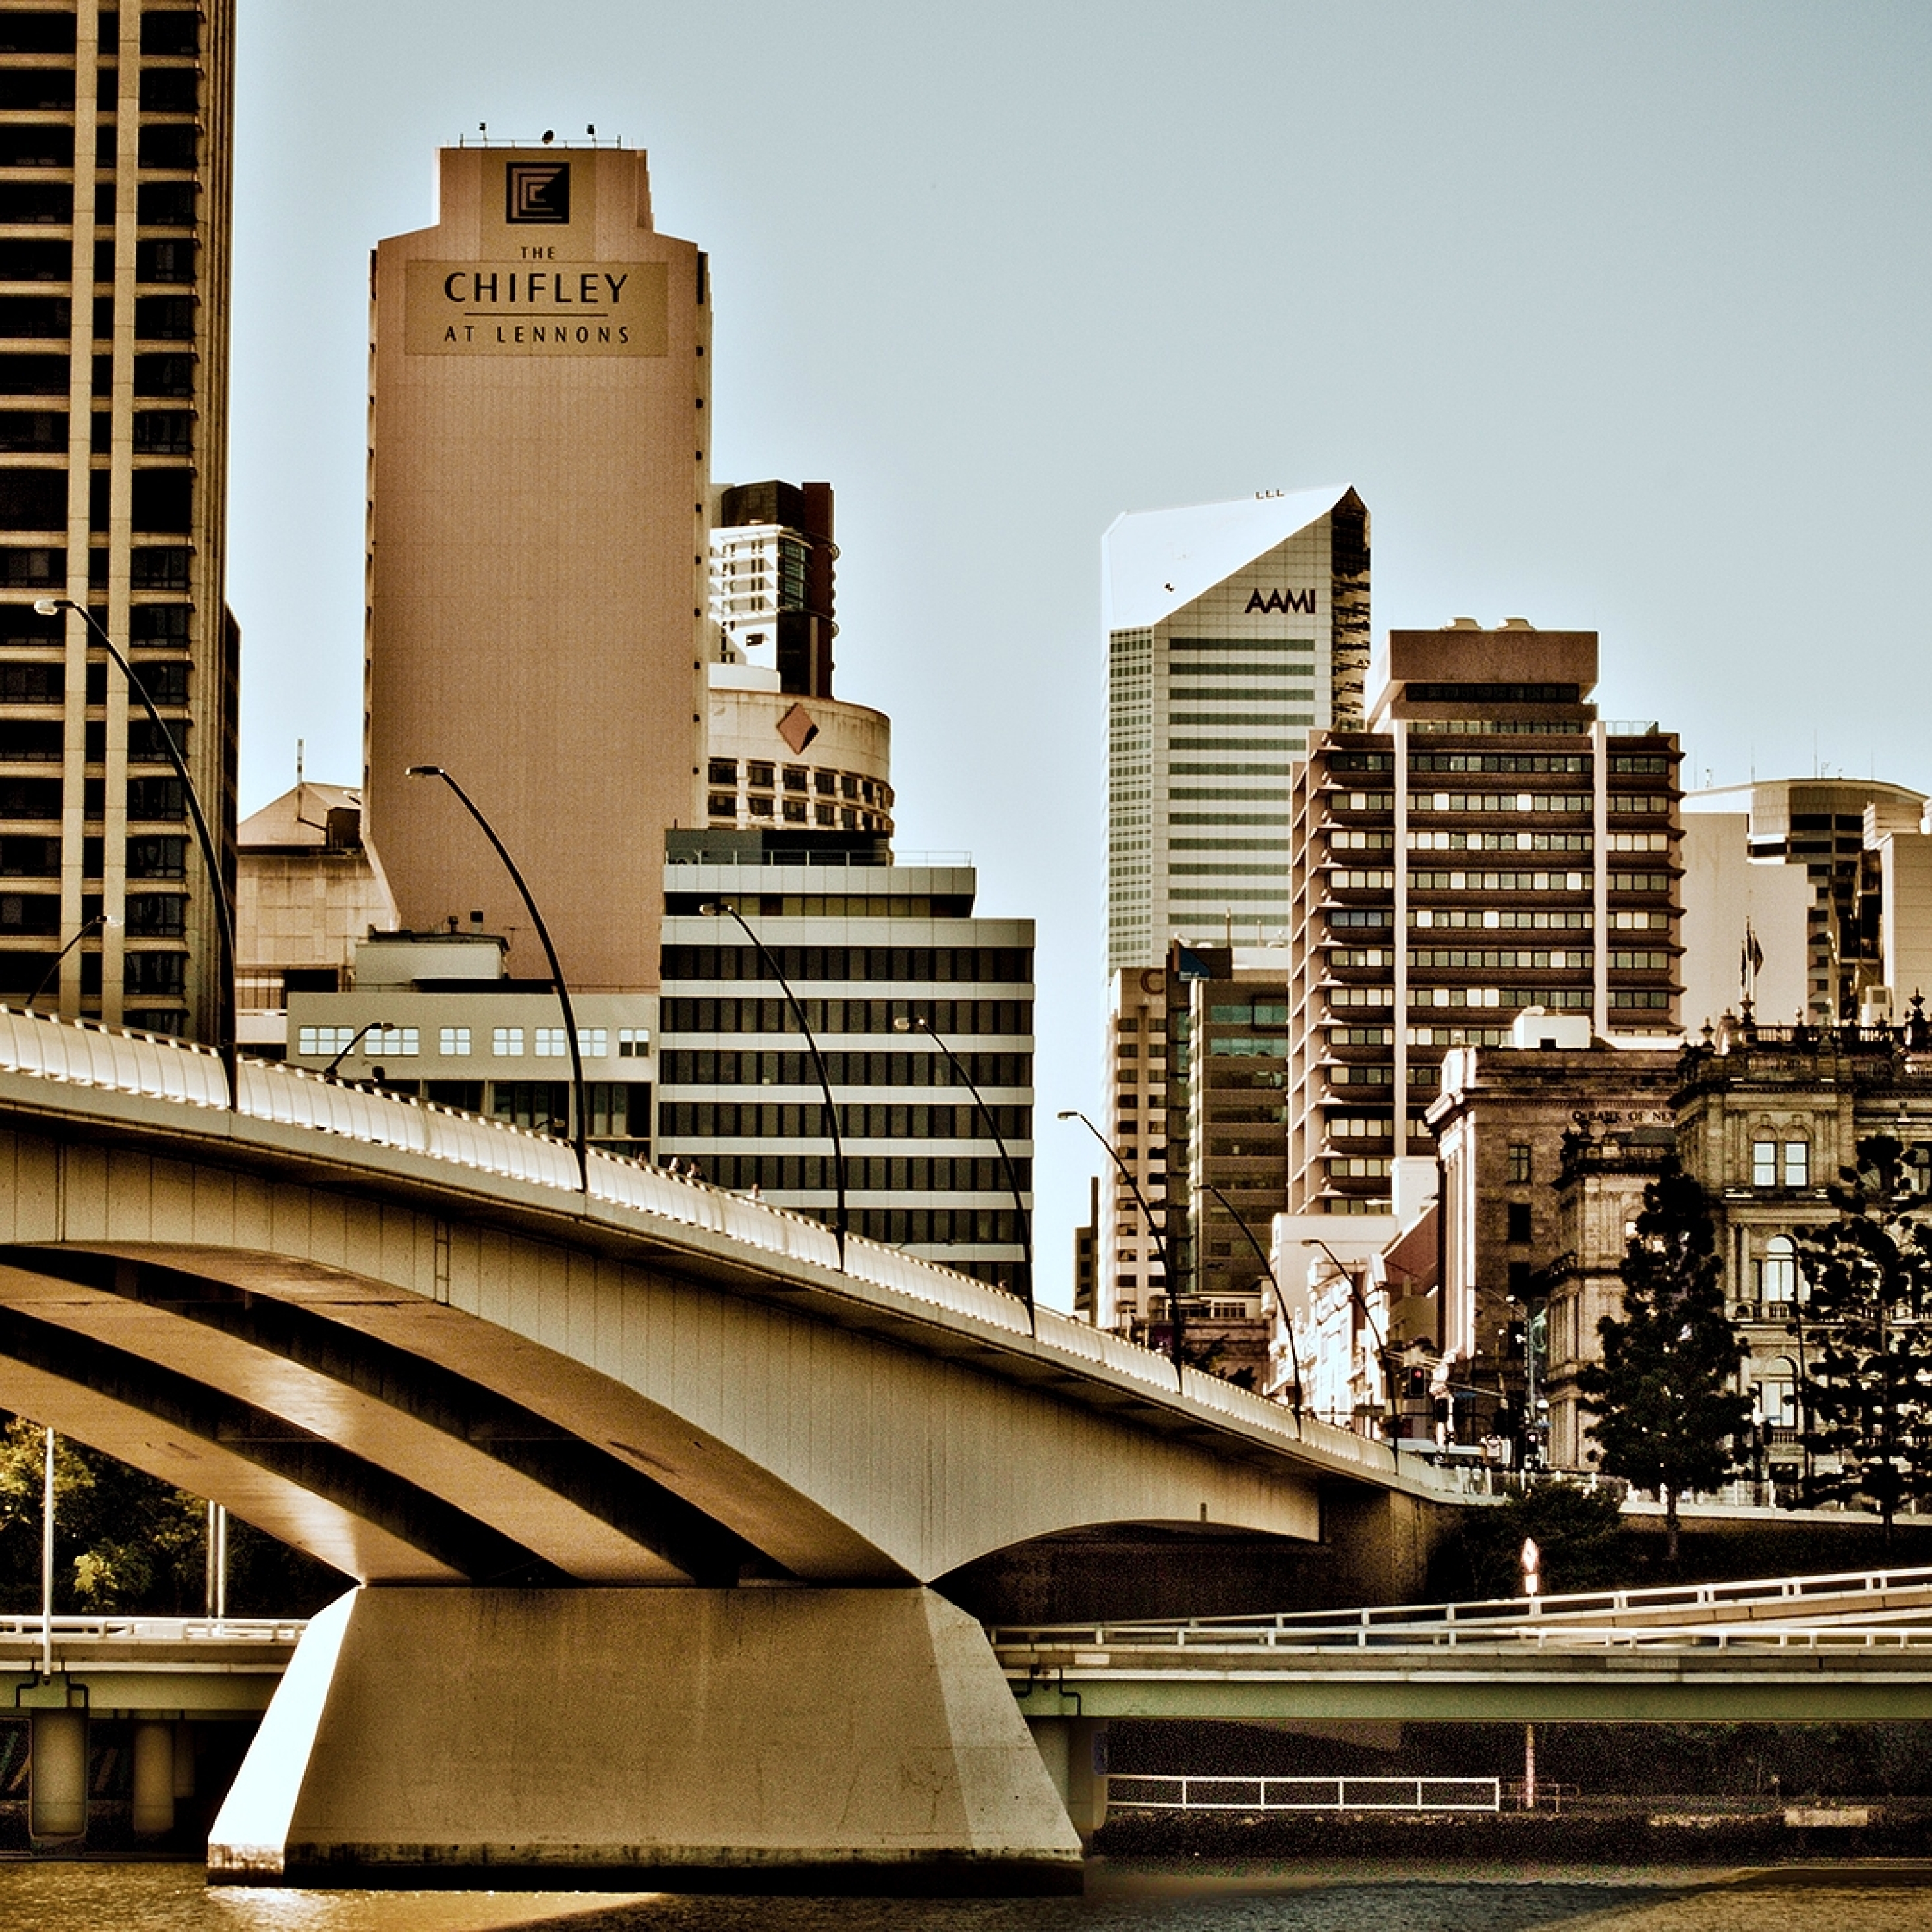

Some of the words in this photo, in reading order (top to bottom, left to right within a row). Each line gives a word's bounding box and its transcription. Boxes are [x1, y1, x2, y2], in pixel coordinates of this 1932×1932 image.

[520, 246, 555, 260] THE
[444, 271, 629, 304] CHIFLEY
[444, 325, 475, 343] AT
[496, 326, 629, 343] LENNONS
[1243, 588, 1316, 614] AAMI
